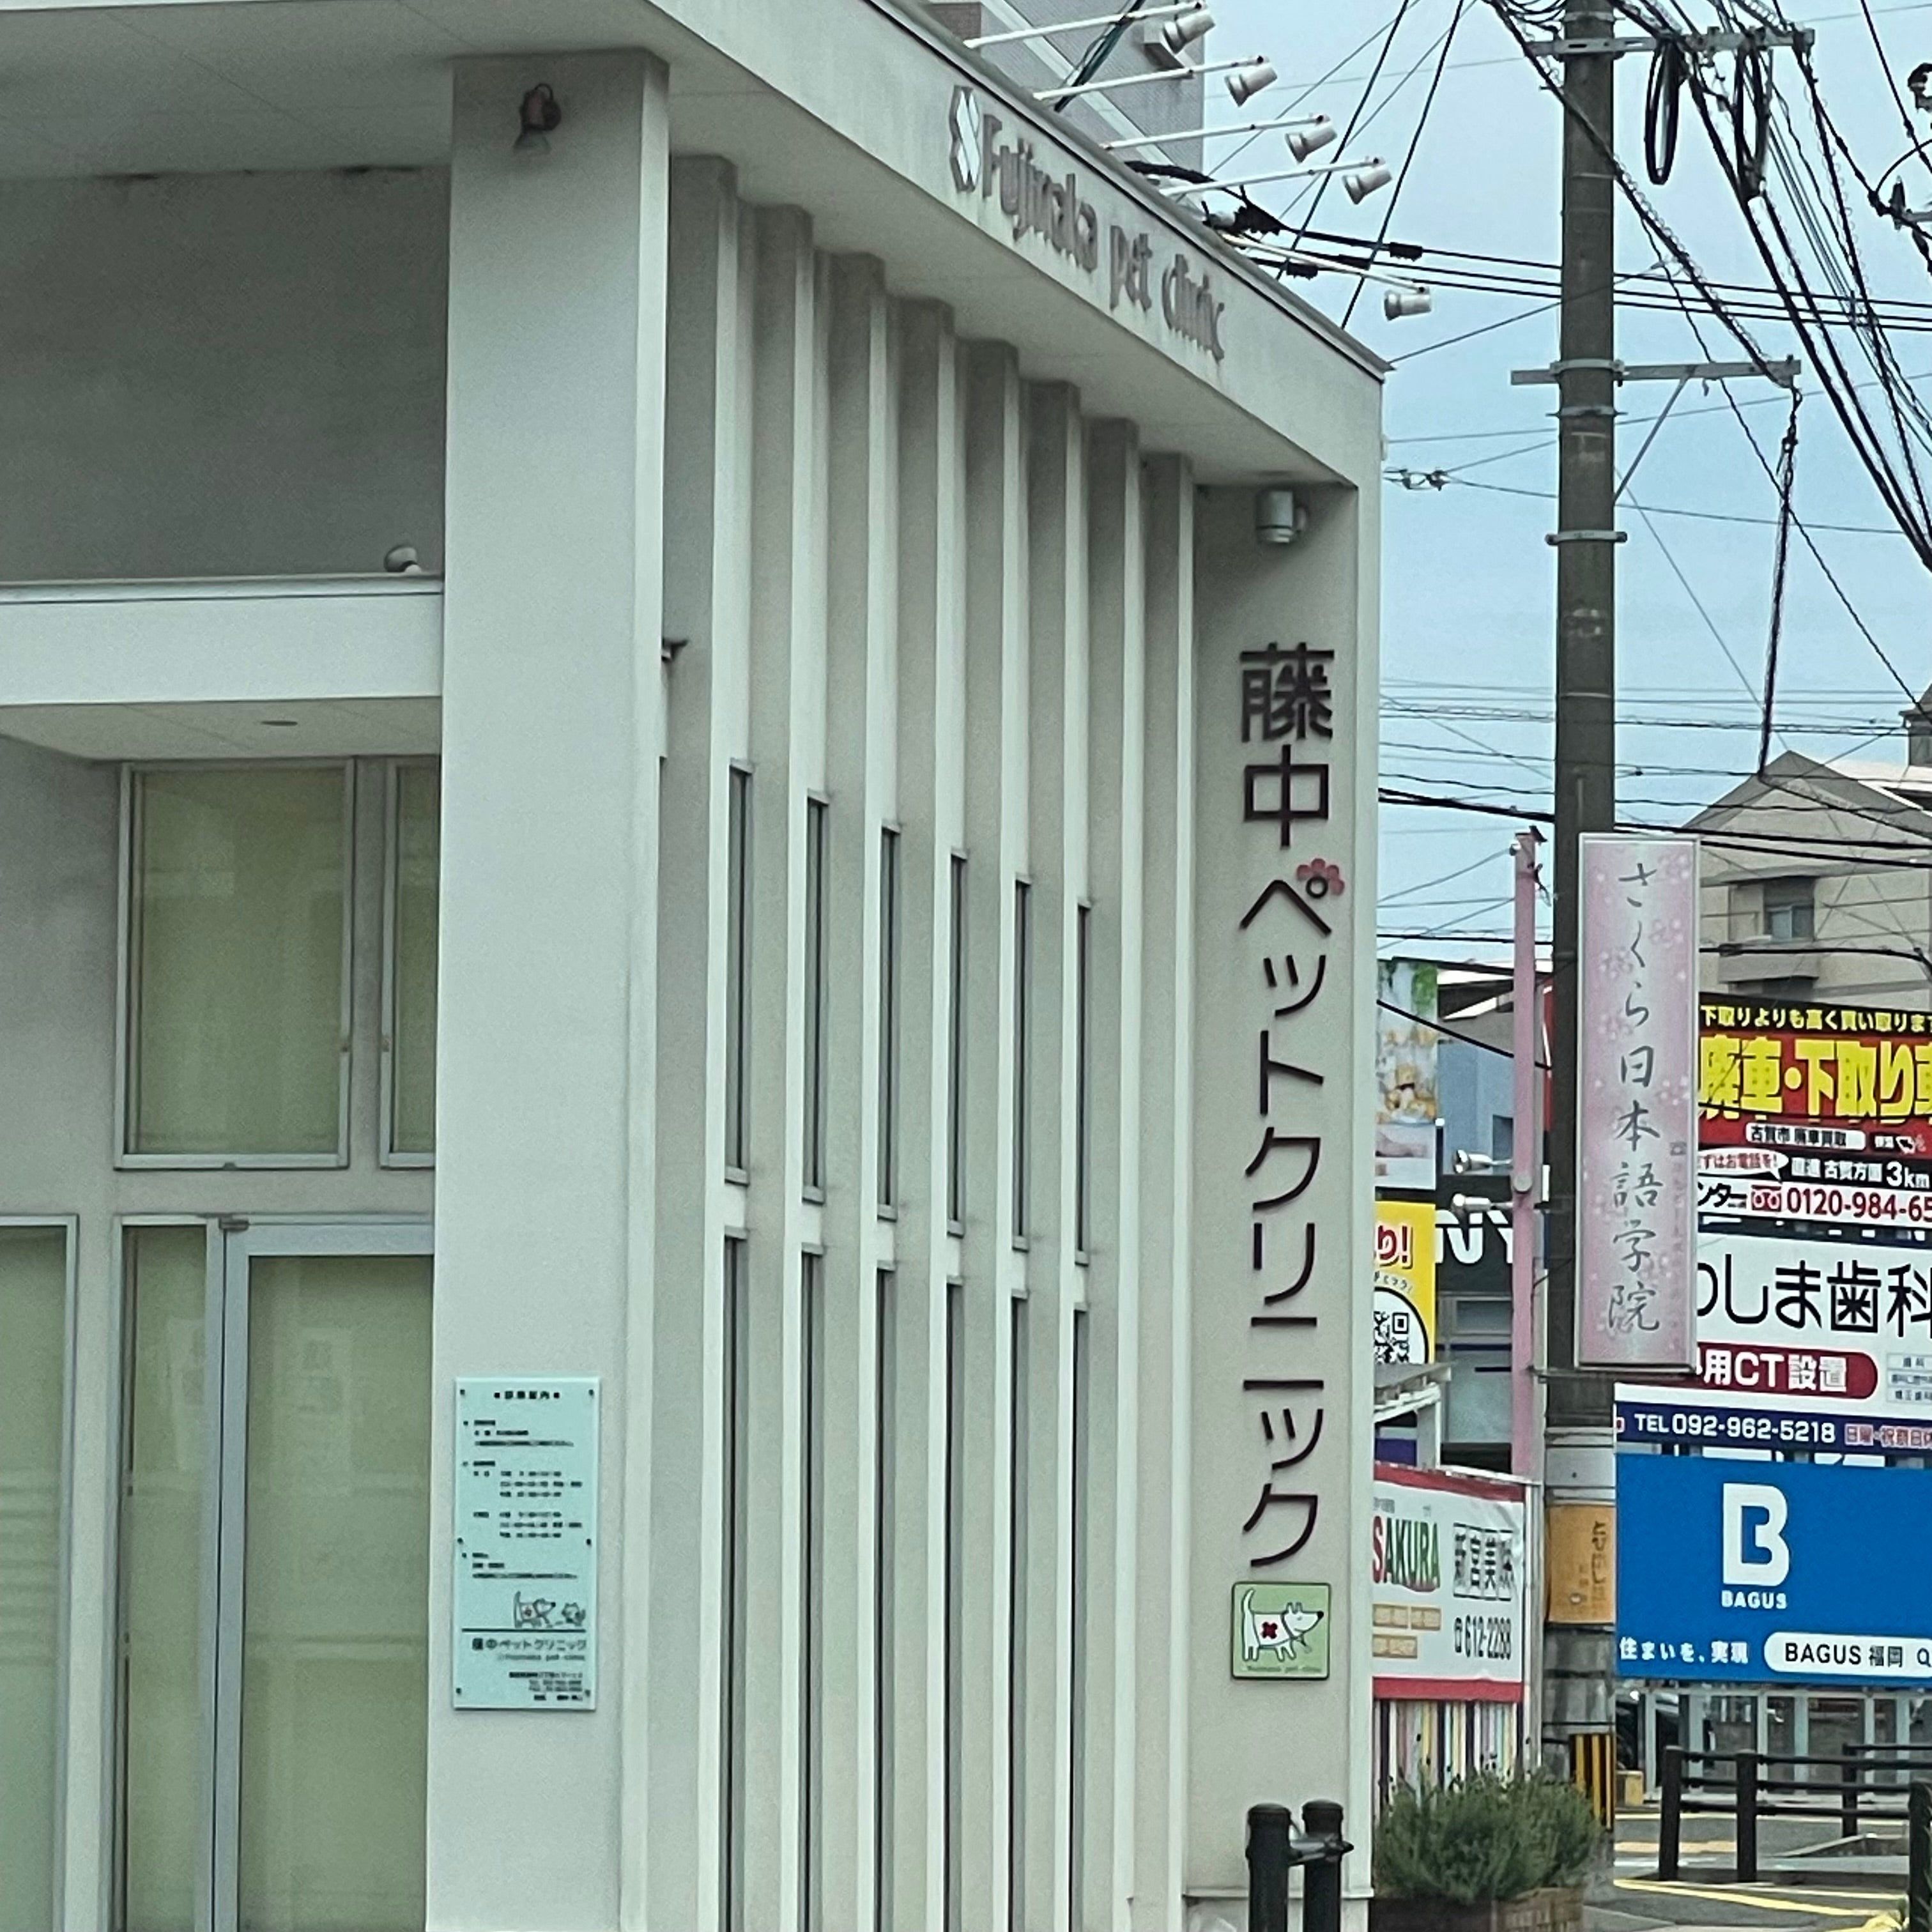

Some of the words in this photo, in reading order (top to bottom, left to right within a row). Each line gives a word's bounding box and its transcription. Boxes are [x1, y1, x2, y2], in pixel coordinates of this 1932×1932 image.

[1701, 1005, 1932, 1032] 下取りよりも高く買い取りま
[1239, 641, 1335, 1568] 藤中ペットクリニック
[1608, 862, 1664, 1331] さくら日本語学院
[1886, 1161, 1930, 1188] 3km
[1697, 1346, 1848, 1393] 用CT設置
[1673, 1413, 1836, 1443] 092-962-5218
[1372, 1515, 1441, 1592] SAKURA
[1721, 1590, 1787, 1609] BAGUS
[1619, 1636, 1749, 1664] 住まいを、実現
[1785, 1643, 1862, 1665] BAGUS
[1868, 1644, 1903, 1668] 福岡
